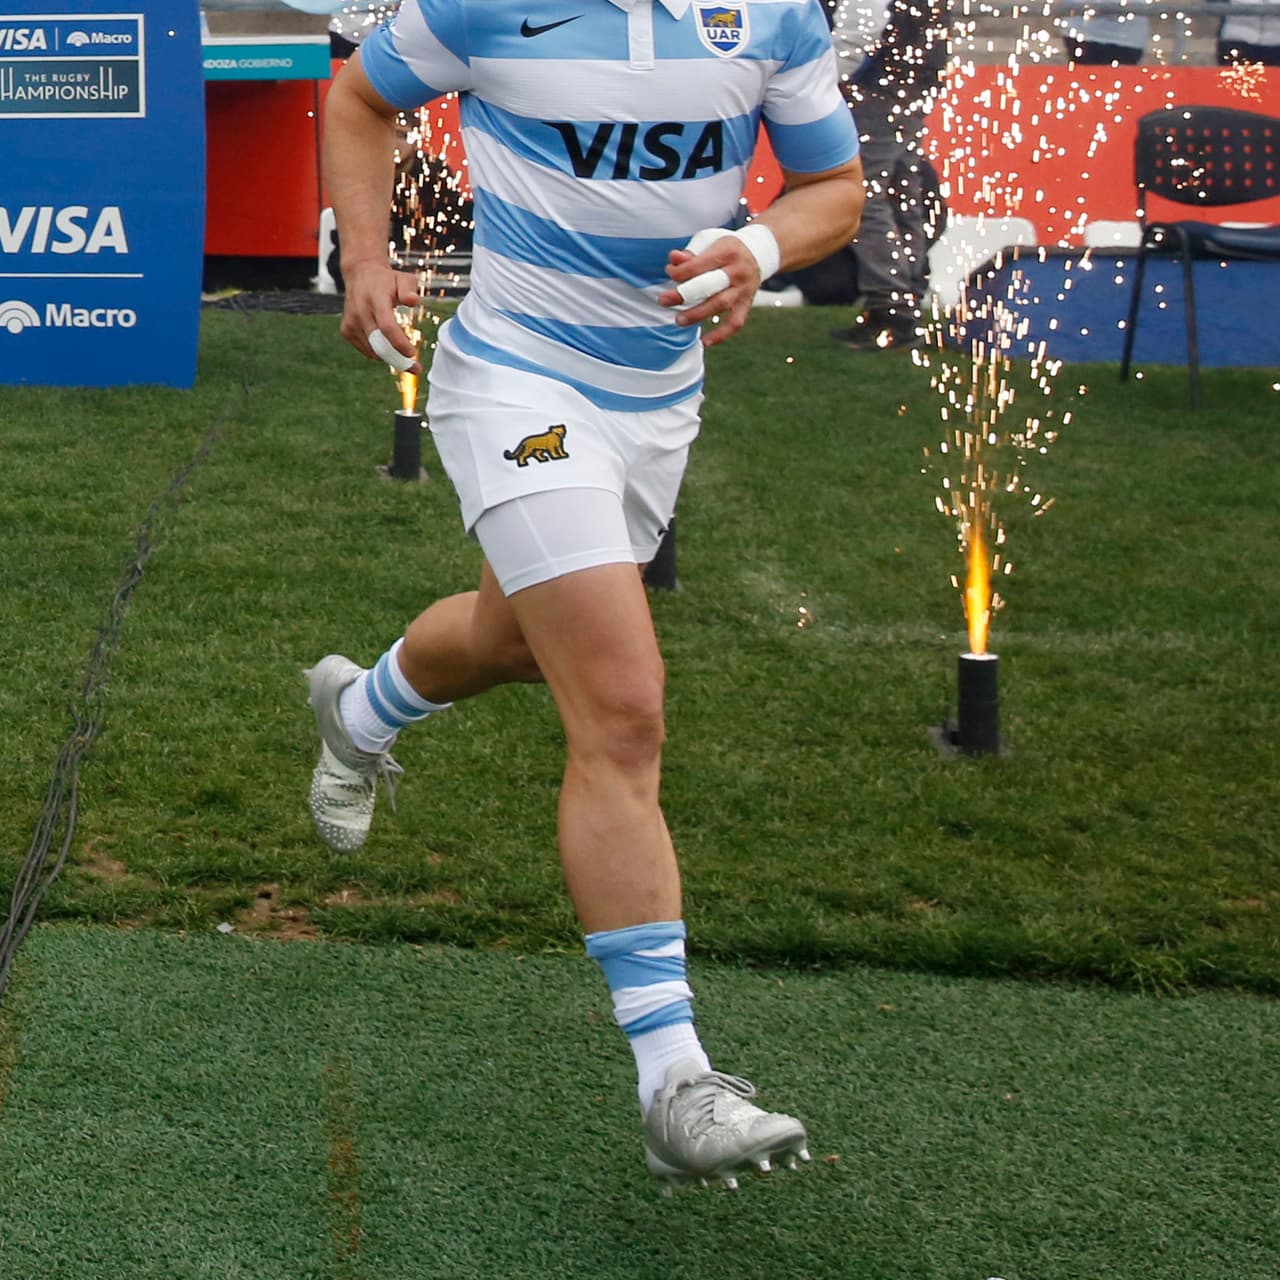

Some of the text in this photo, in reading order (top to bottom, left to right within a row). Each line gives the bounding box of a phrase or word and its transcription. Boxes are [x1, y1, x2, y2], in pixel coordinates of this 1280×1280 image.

[91, 32, 132, 44] Macro
[706, 28, 742, 41] UAR
[24, 72, 90, 83] THE RUGBY
[541, 121, 724, 181] VISA
[45, 303, 137, 327] Macro
